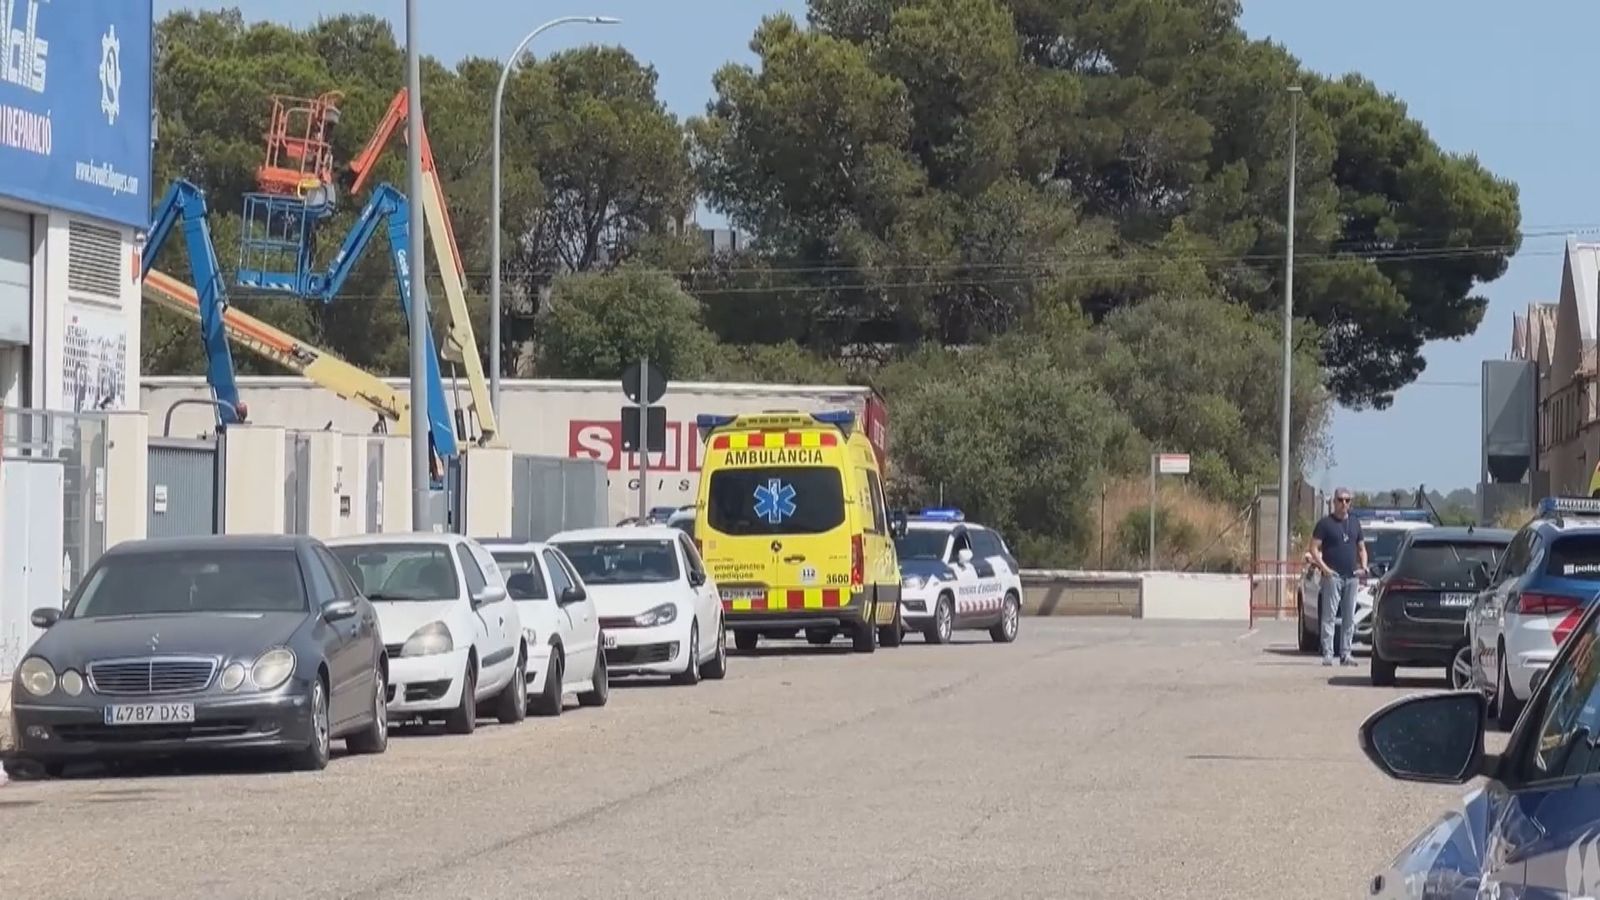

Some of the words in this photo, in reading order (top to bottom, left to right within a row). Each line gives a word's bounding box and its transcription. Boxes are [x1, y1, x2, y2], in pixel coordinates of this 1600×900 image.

[6, 106, 52, 156] REPARACIÓ
[802, 568, 815, 577] 112
[826, 574, 849, 584] 3600
[116, 705, 154, 720] 4787
[160, 704, 190, 720] DXS
